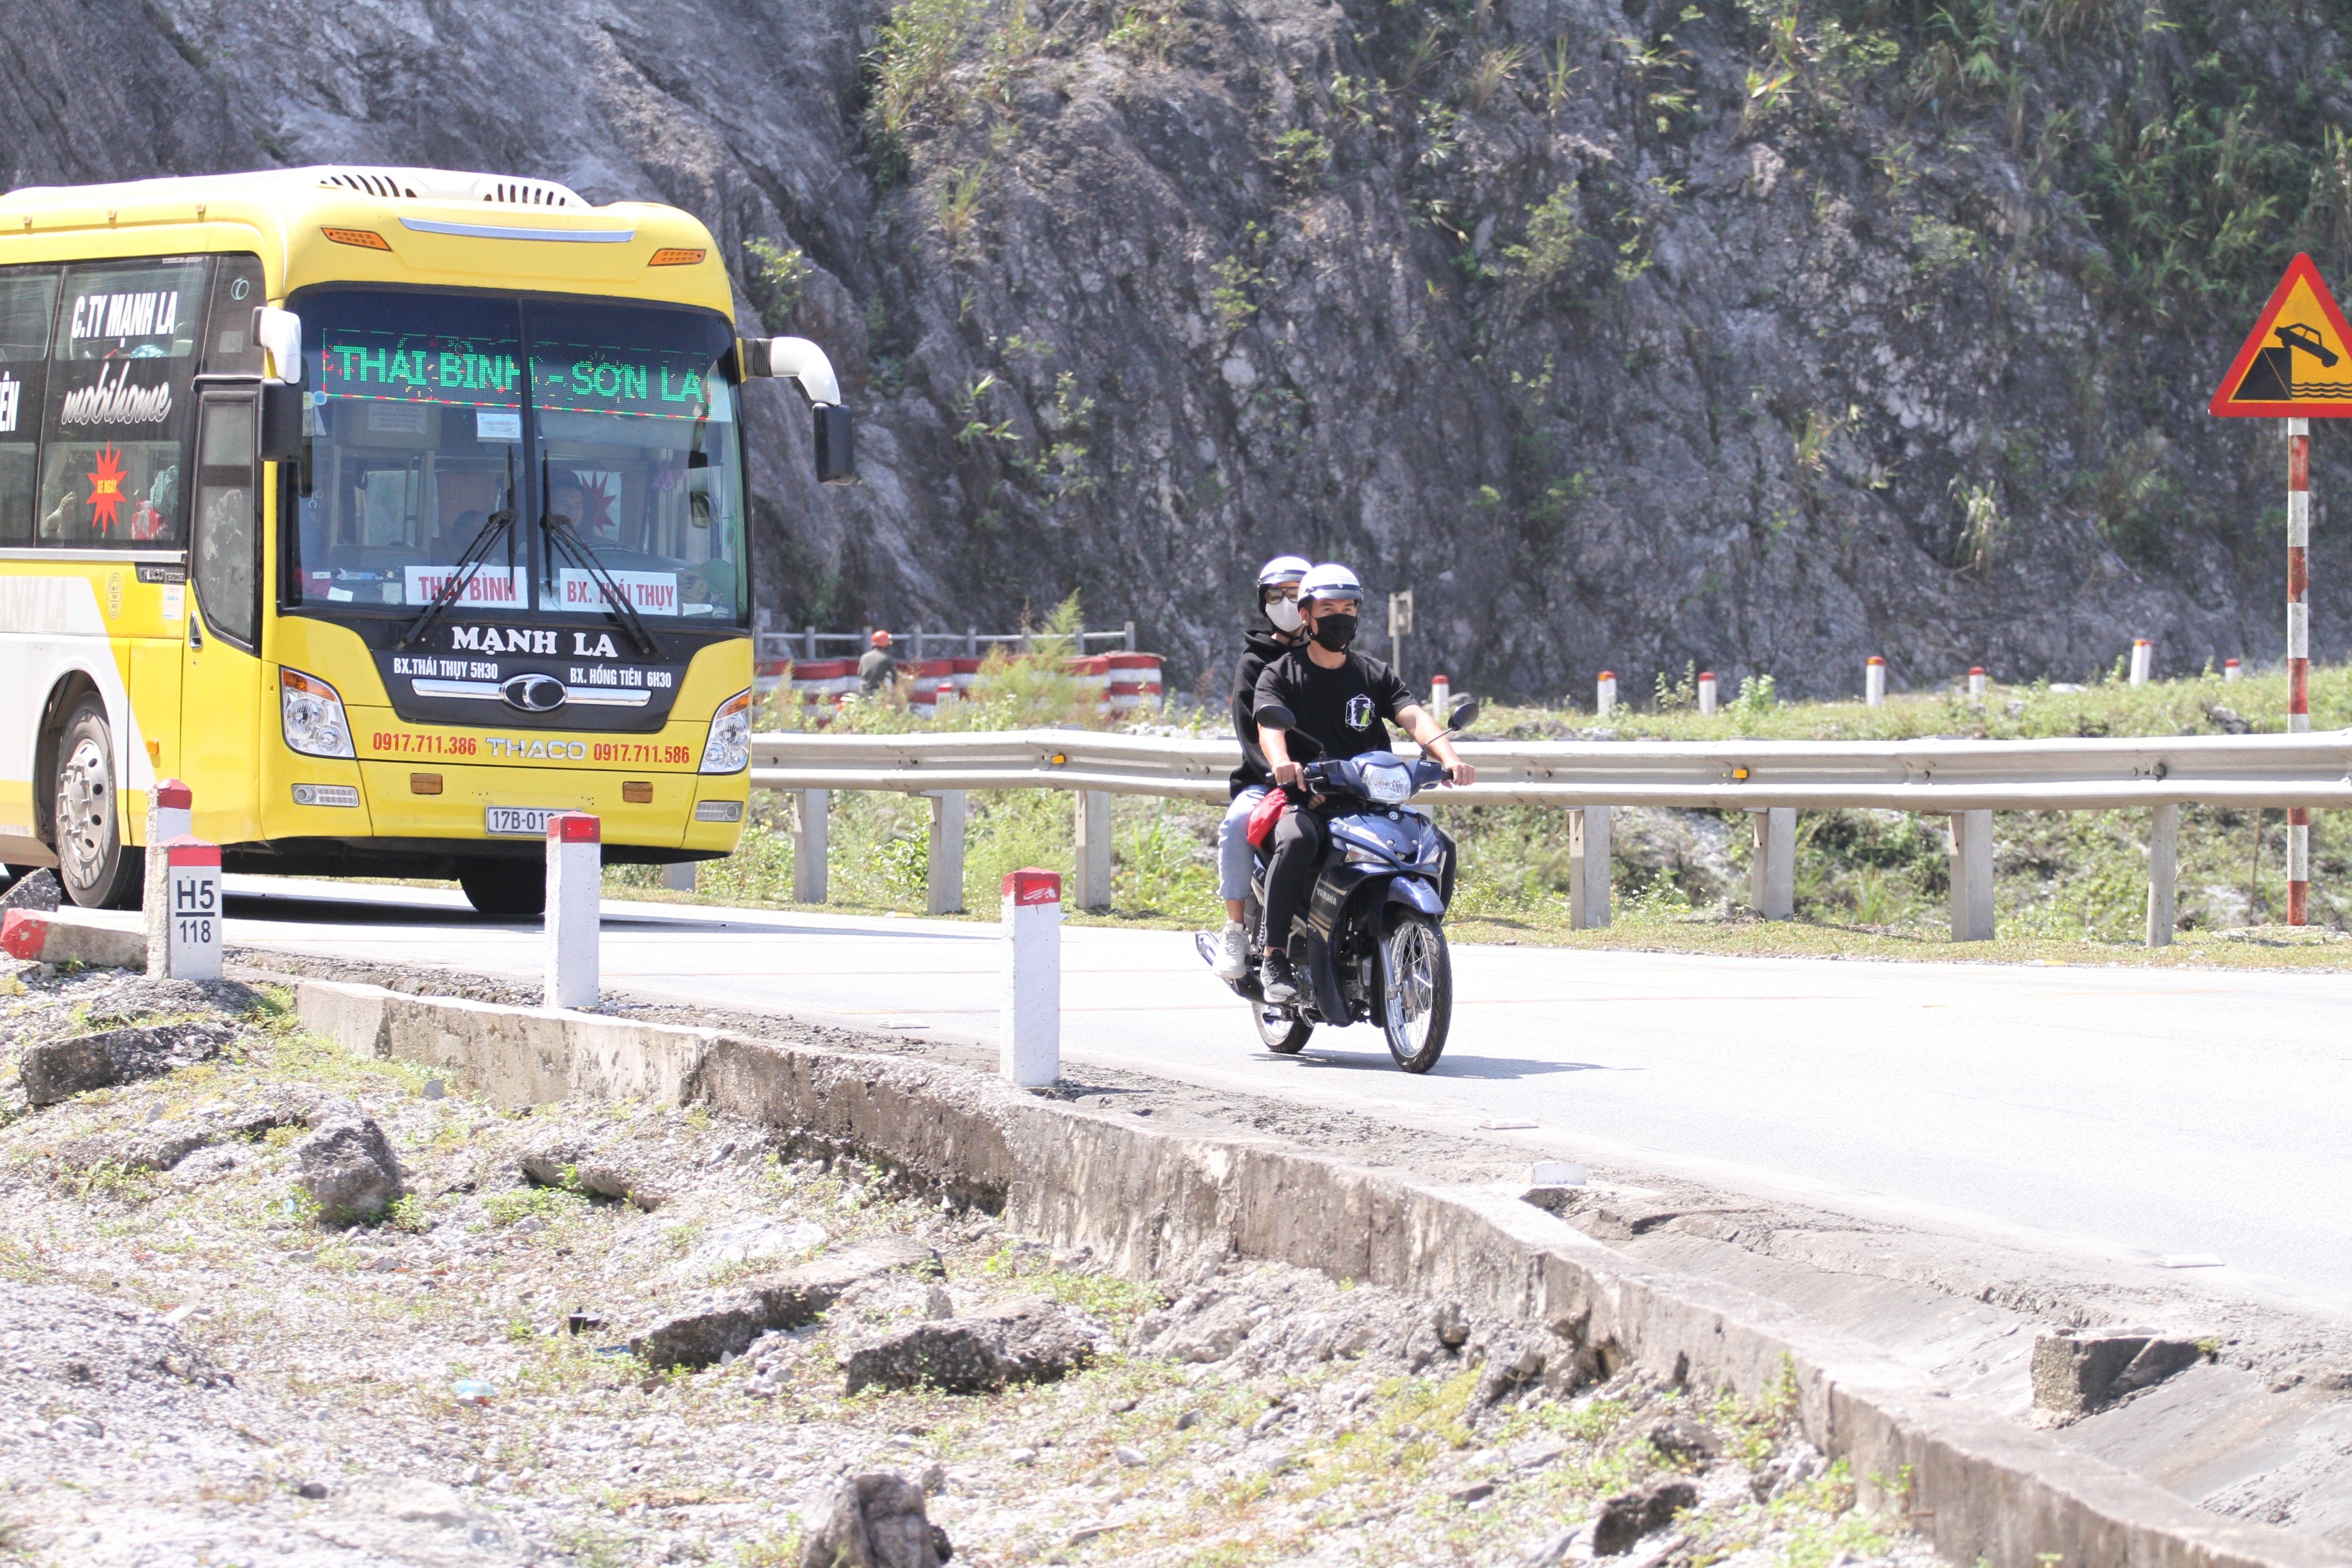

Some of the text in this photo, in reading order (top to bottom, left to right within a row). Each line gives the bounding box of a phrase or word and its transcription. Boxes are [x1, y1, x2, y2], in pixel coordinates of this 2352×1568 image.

[71, 291, 178, 347] C.TY MẠNH LA
[333, 337, 427, 386] THÁI
[661, 366, 705, 403] LA
[0, 370, 21, 432] ÊN
[61, 360, 172, 426] mobihome
[97, 480, 103, 493] XE
[469, 572, 517, 601] BÌNH
[567, 580, 593, 604] BX.
[636, 584, 674, 611] THỤY
[451, 626, 619, 658] MẠNH LA
[393, 656, 499, 680] BX.THÁI THỤY 5H30
[570, 663, 672, 688] BX. HỒNG TIÊN 6H30
[373, 732, 477, 756] 0917.711.386
[485, 737, 586, 761] THACO
[593, 743, 690, 764] 0917.711.586
[493, 809, 554, 831] 17B-01
[176, 879, 215, 910] H5
[1316, 887, 1337, 906] YAMAHA
[179, 920, 211, 944] 118
